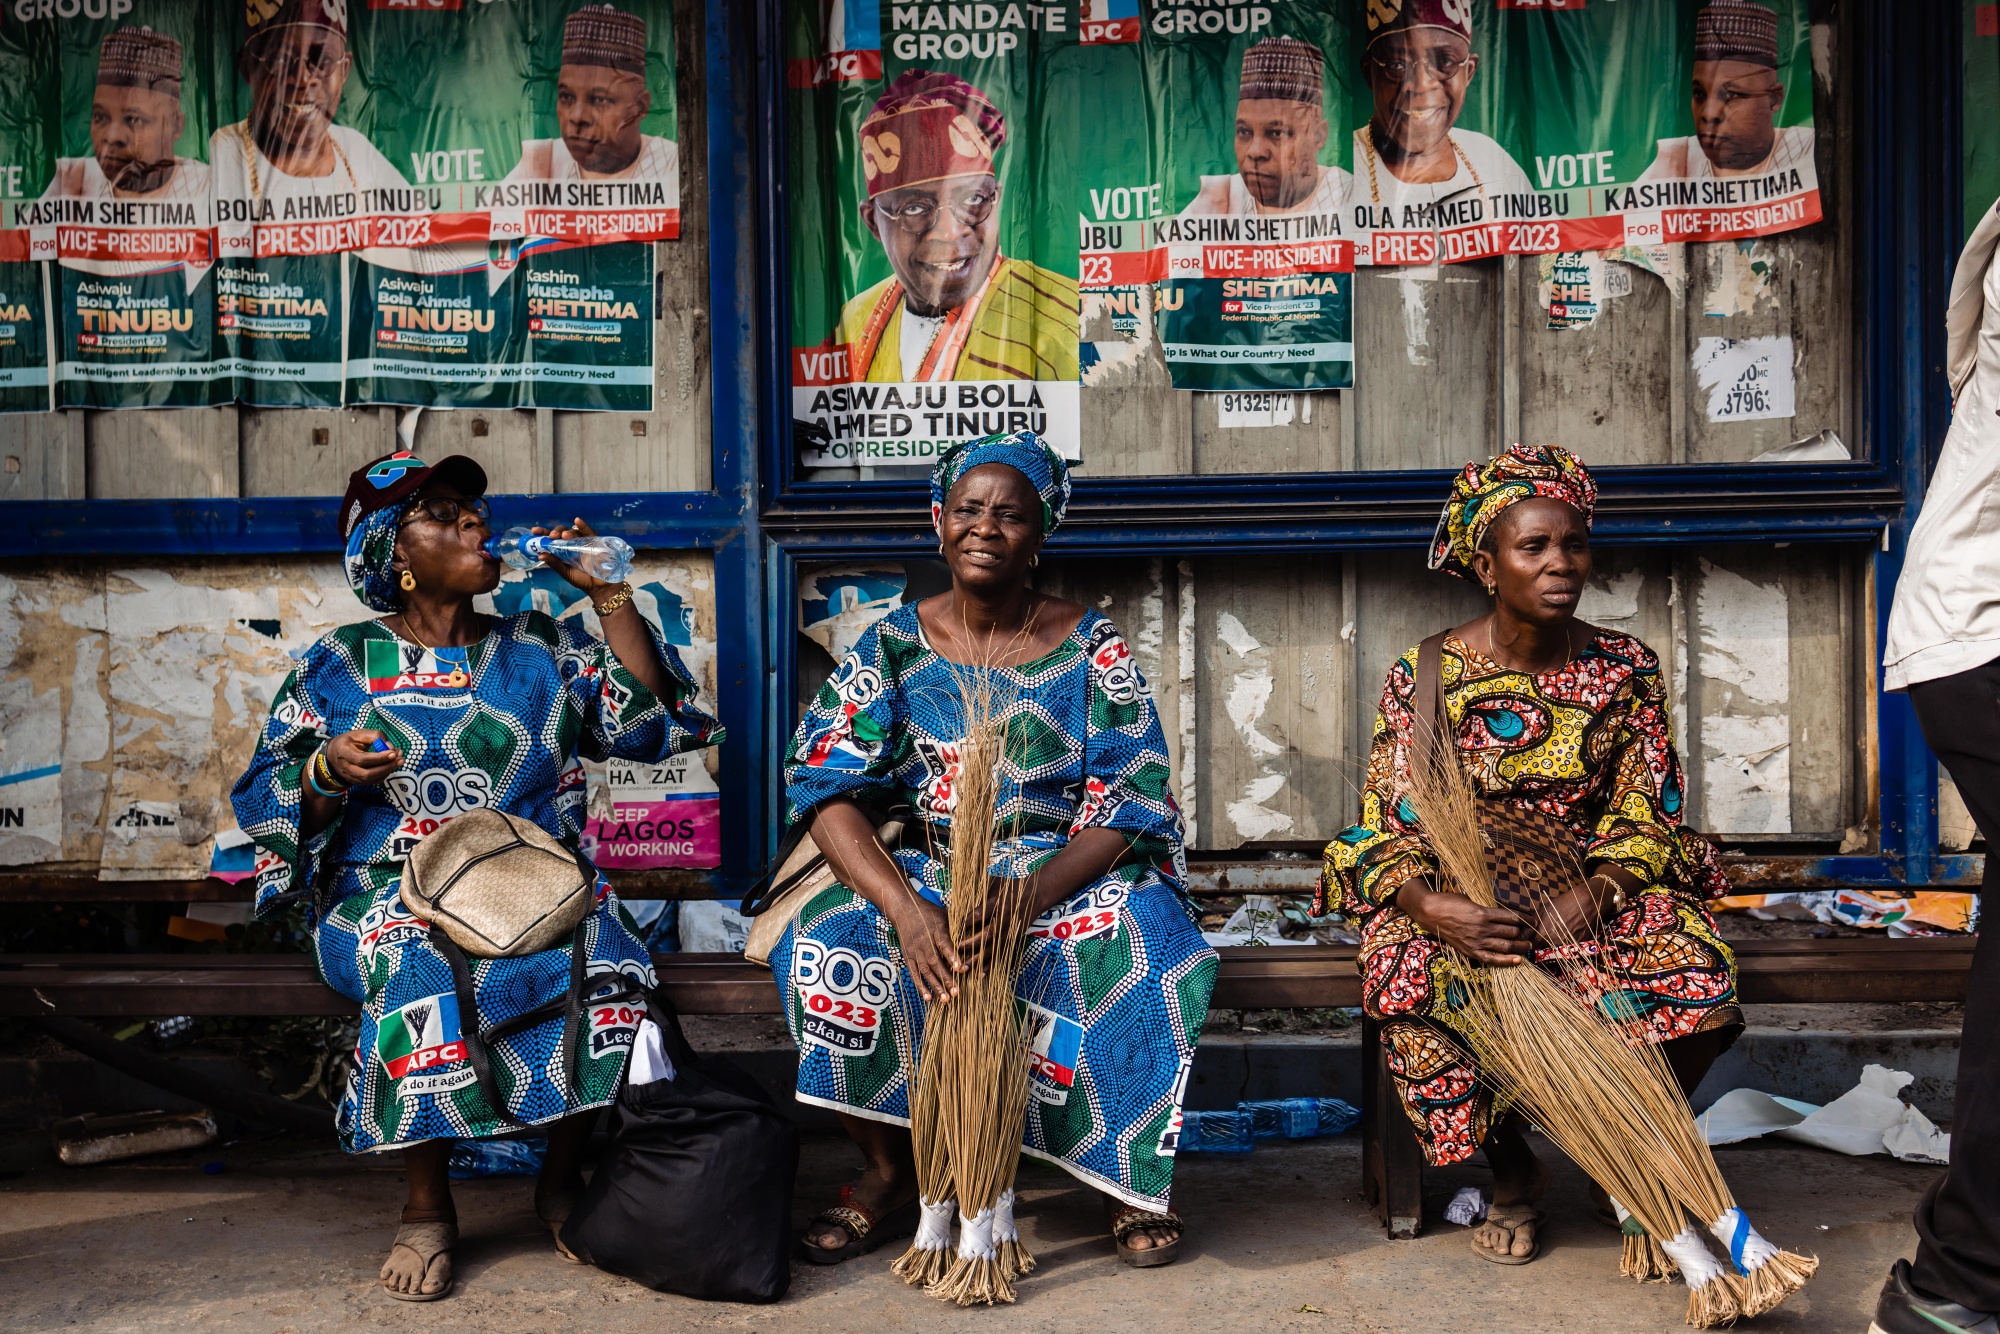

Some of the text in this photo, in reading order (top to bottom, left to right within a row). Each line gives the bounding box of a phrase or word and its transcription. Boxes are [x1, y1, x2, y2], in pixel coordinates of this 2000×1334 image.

[14, 0, 132, 22] GROUP
[893, 4, 1066, 32] MANDATE
[1151, 7, 1272, 34] GROUP
[893, 34, 1018, 60] GROUP
[412, 148, 485, 182] VOTE
[1536, 150, 1616, 188] VOTE
[475, 181, 666, 208] KASHIM SHETTIMA
[1605, 168, 1804, 212] KASHIM SHETTIMA
[14, 201, 196, 226] KASHIM SHETTIMA
[217, 186, 442, 222] BOLA AHMED TINUBU
[1090, 184, 1163, 221] VOTE
[1402, 197, 1484, 229] AHMED
[1488, 192, 1571, 220] TINUBU
[493, 212, 666, 235] FOR VICE-PRESIDENT
[1153, 212, 1343, 244] KASHIM SHETTIMA
[1627, 197, 1807, 238] FOR VICE-PRESIDENT
[33, 230, 197, 254] FOR VICE-PRESIDENT
[220, 217, 431, 255] FOR PRESIDENT 2023
[1375, 226, 1503, 262] PRESIDENT
[1507, 223, 1561, 252] 2023
[1171, 243, 1344, 271] FOR VICE-PRESIDENT
[216, 266, 270, 284] Kashim
[526, 268, 580, 285] Kashim
[77, 282, 132, 298] Asiwaju
[217, 280, 304, 301] Mustapha
[378, 277, 434, 296] Asiwaju
[527, 283, 615, 302] Mustapha
[1222, 277, 1339, 298] SHETTIMA
[76, 295, 169, 309] Bola Ahmed
[218, 294, 328, 316] SHETTIMA
[377, 291, 472, 309] Bola Ahmed
[528, 298, 640, 320] SHETTIMA
[1225, 302, 1241, 312] for
[1245, 303, 1262, 312] Vice
[1264, 302, 1301, 311] President
[1551, 306, 1565, 316] for
[1570, 307, 1588, 315] Vice
[77, 309, 194, 333] TINUBU
[377, 304, 496, 333] TINUBU
[546, 321, 563, 329] Vice
[565, 323, 602, 332] President
[1221, 312, 1321, 324] Federal Republic of Nigeria
[81, 335, 95, 345] for
[101, 336, 147, 345] President
[376, 341, 402, 350] Federal
[435, 345, 443, 353] of
[443, 346, 468, 356] Nigeria
[380, 331, 395, 341] for
[400, 333, 448, 345] President
[551, 334, 621, 345] Republic of Nigeria
[1179, 348, 1315, 361] Is What Our Country Need
[74, 366, 130, 379] Intelligent
[132, 366, 187, 377] Leadership
[189, 367, 199, 375] Is
[234, 362, 276, 377] Country
[278, 367, 306, 376] Need
[373, 362, 428, 376] Intelligent
[430, 367, 487, 379] Leadership
[542, 367, 586, 380] Country
[588, 370, 616, 380] Need
[801, 350, 849, 382] VOTE
[958, 384, 1046, 410] BOLA
[811, 411, 1047, 441] AHMED TINUBU
[409, 693, 425, 706] do
[426, 694, 437, 707] it
[437, 697, 469, 709] again
[609, 769, 687, 785] HAZAT
[385, 772, 491, 817] BOS
[597, 819, 696, 843] LAGOS
[609, 841, 695, 858] WORKING
[794, 942, 894, 1006] BOS
[849, 1035, 865, 1049] si
[405, 1044, 460, 1072] APC
[410, 1070, 475, 1090] do it again
[1036, 1085, 1061, 1102] again
